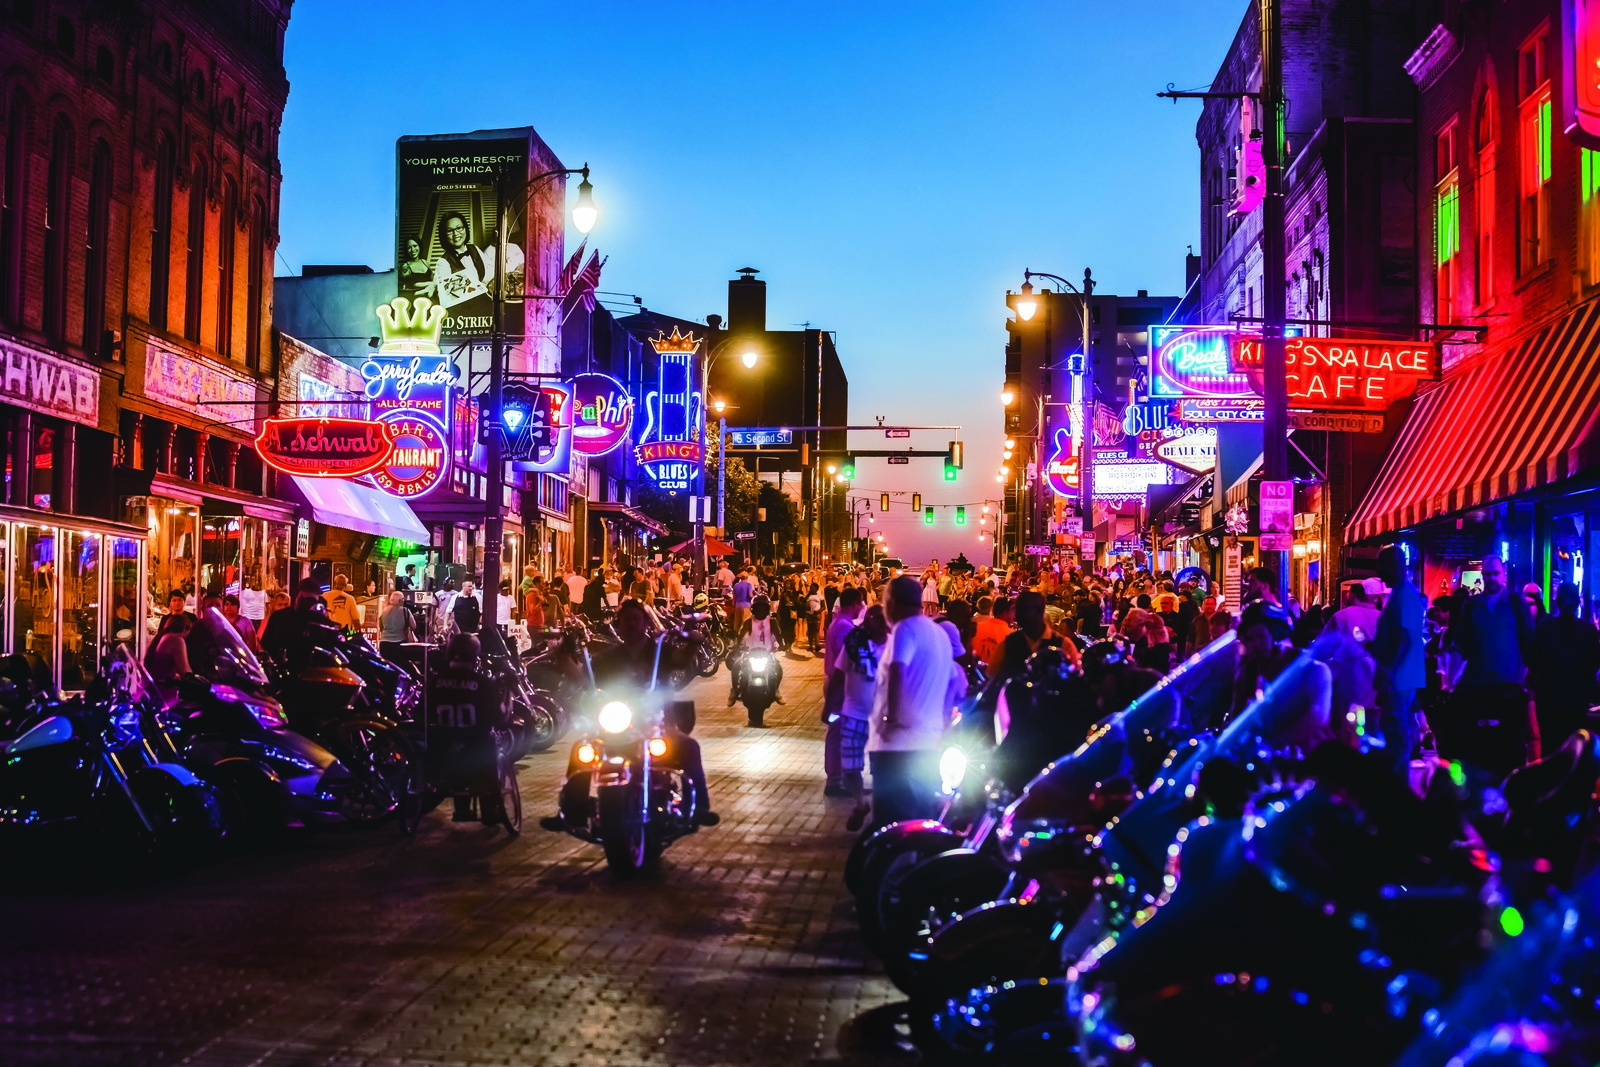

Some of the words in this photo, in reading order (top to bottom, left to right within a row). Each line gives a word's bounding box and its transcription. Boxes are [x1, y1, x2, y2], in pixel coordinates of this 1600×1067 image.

[441, 156, 470, 164] MGM
[448, 165, 493, 174] TUNICA
[442, 317, 455, 329] LD
[1239, 340, 1317, 366] KIG'S
[0, 349, 94, 415] HWAB
[399, 400, 412, 409] OF
[416, 400, 443, 409] FAME
[574, 391, 636, 428] emphis
[1184, 410, 1214, 419] SOUL
[1216, 410, 1238, 419] CITY
[1288, 415, 1299, 427] IR
[389, 421, 424, 437] BAR
[290, 424, 385, 452] Schwab
[746, 432, 775, 443] Second
[1163, 446, 1197, 456] BEALE
[284, 457, 346, 469] ESTABLISHED
[659, 463, 688, 480] BLUES
[373, 471, 392, 489] 159
[397, 470, 436, 494] BEALE
[659, 481, 687, 489] CLUB
[1266, 485, 1286, 496] NO
[395, 539, 414, 549] ATM
